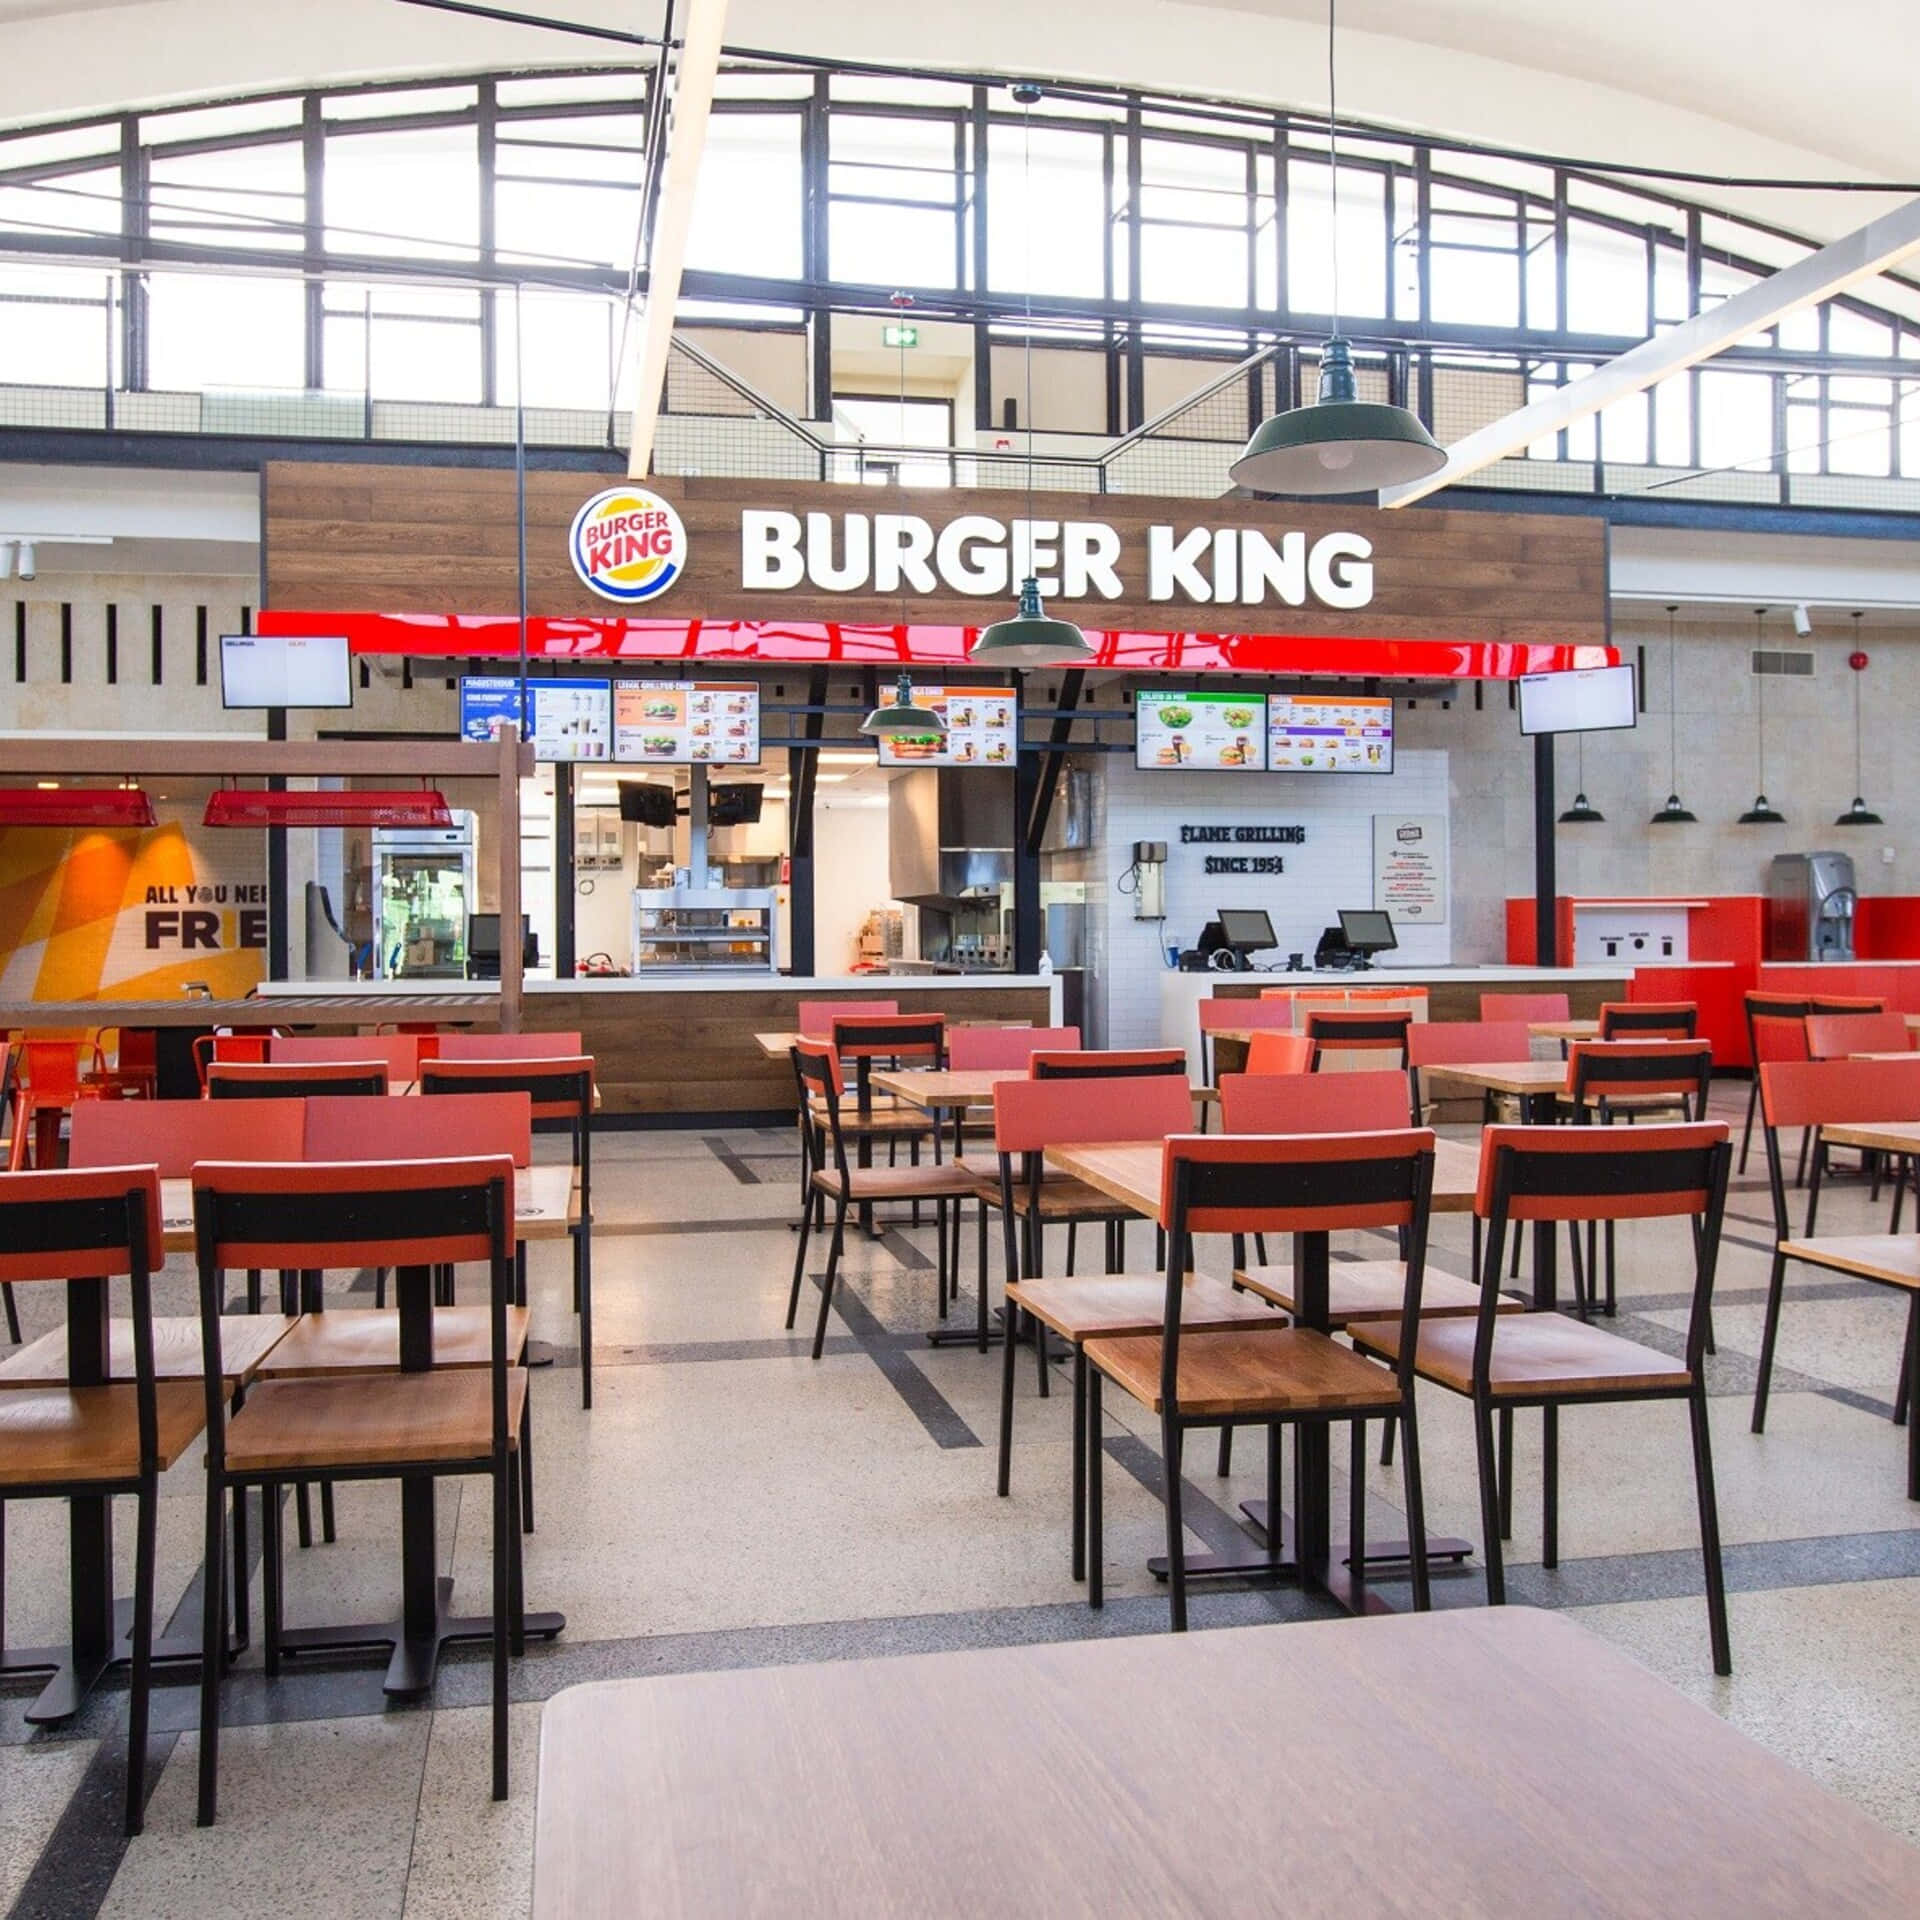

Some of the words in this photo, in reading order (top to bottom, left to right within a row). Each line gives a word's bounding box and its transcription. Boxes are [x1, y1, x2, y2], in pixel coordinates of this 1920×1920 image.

[586, 511, 669, 547] BURGER
[590, 529, 672, 575] KING
[741, 509, 1123, 600] BURGER
[1149, 525, 1374, 609] KING
[1180, 825, 1232, 843] FLAME
[1235, 825, 1305, 844] GRILLING
[1205, 855, 1249, 874] SINCE
[1251, 855, 1283, 874] 1954
[145, 885, 178, 904] ALL
